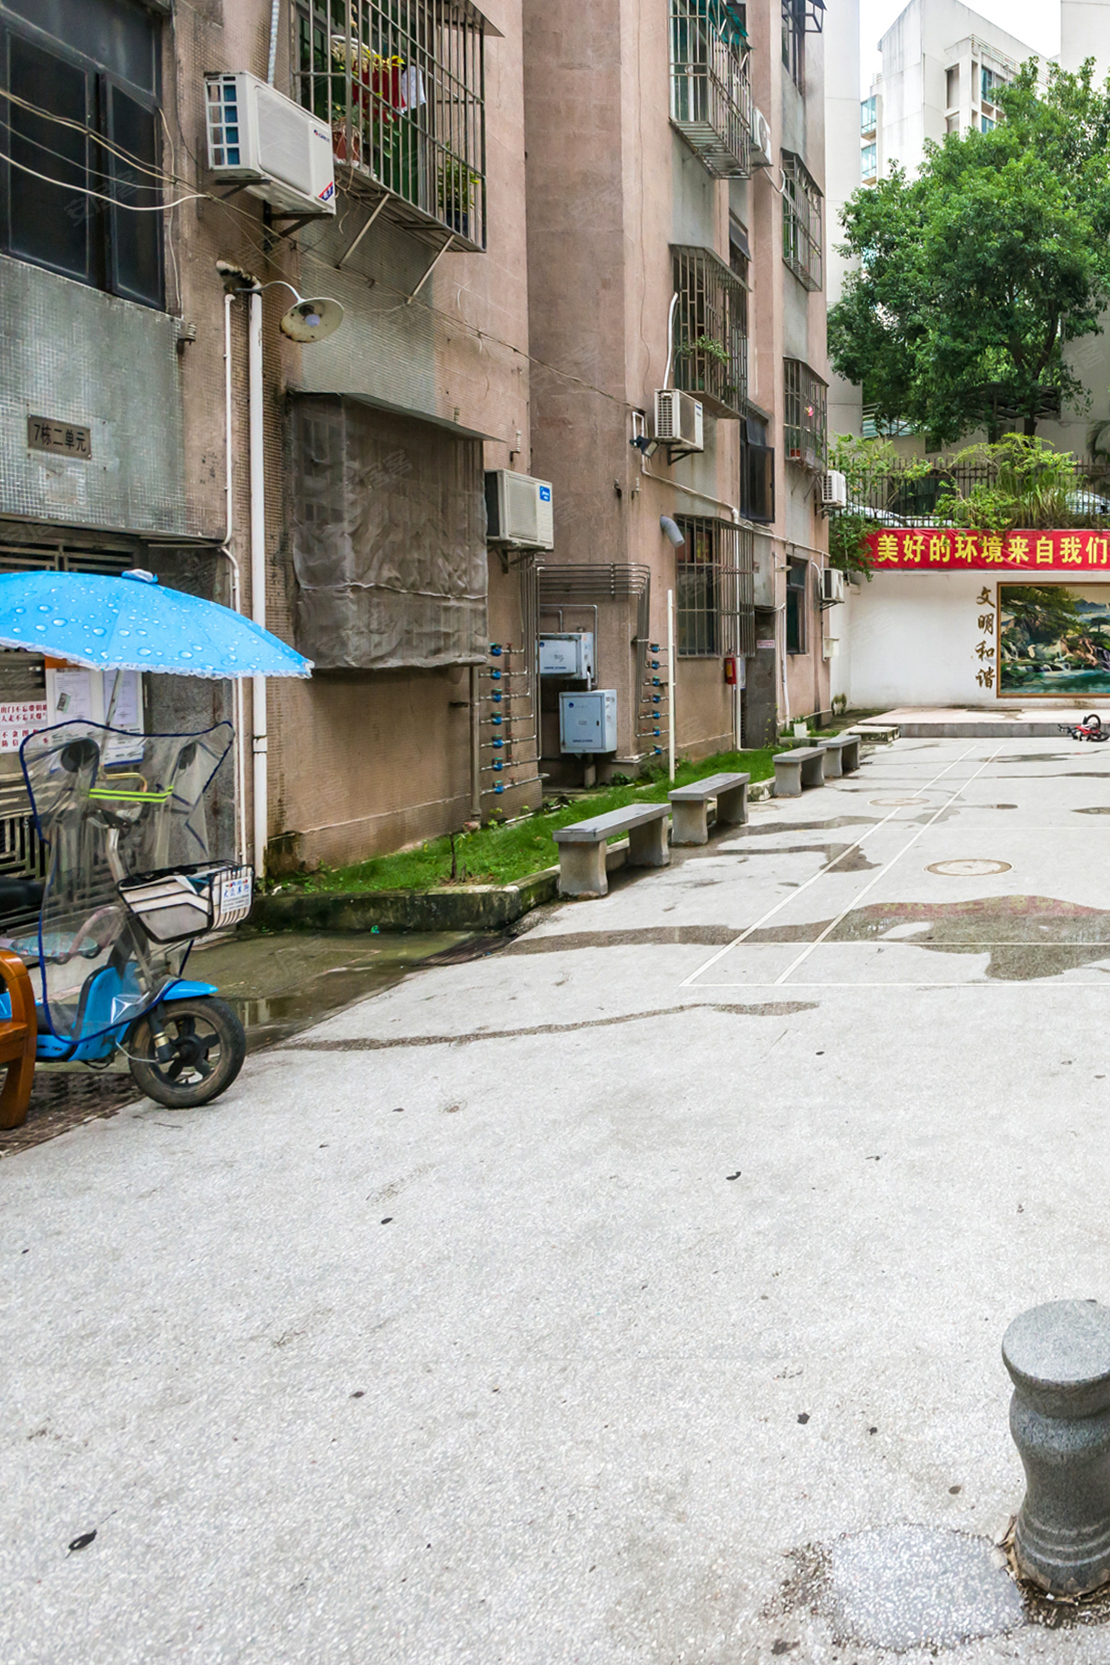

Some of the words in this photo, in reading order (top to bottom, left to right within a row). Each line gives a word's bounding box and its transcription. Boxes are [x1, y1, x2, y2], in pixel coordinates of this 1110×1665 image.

[33, 424, 86, 452] 7栋二单元
[975, 586, 996, 689] 文明和谐
